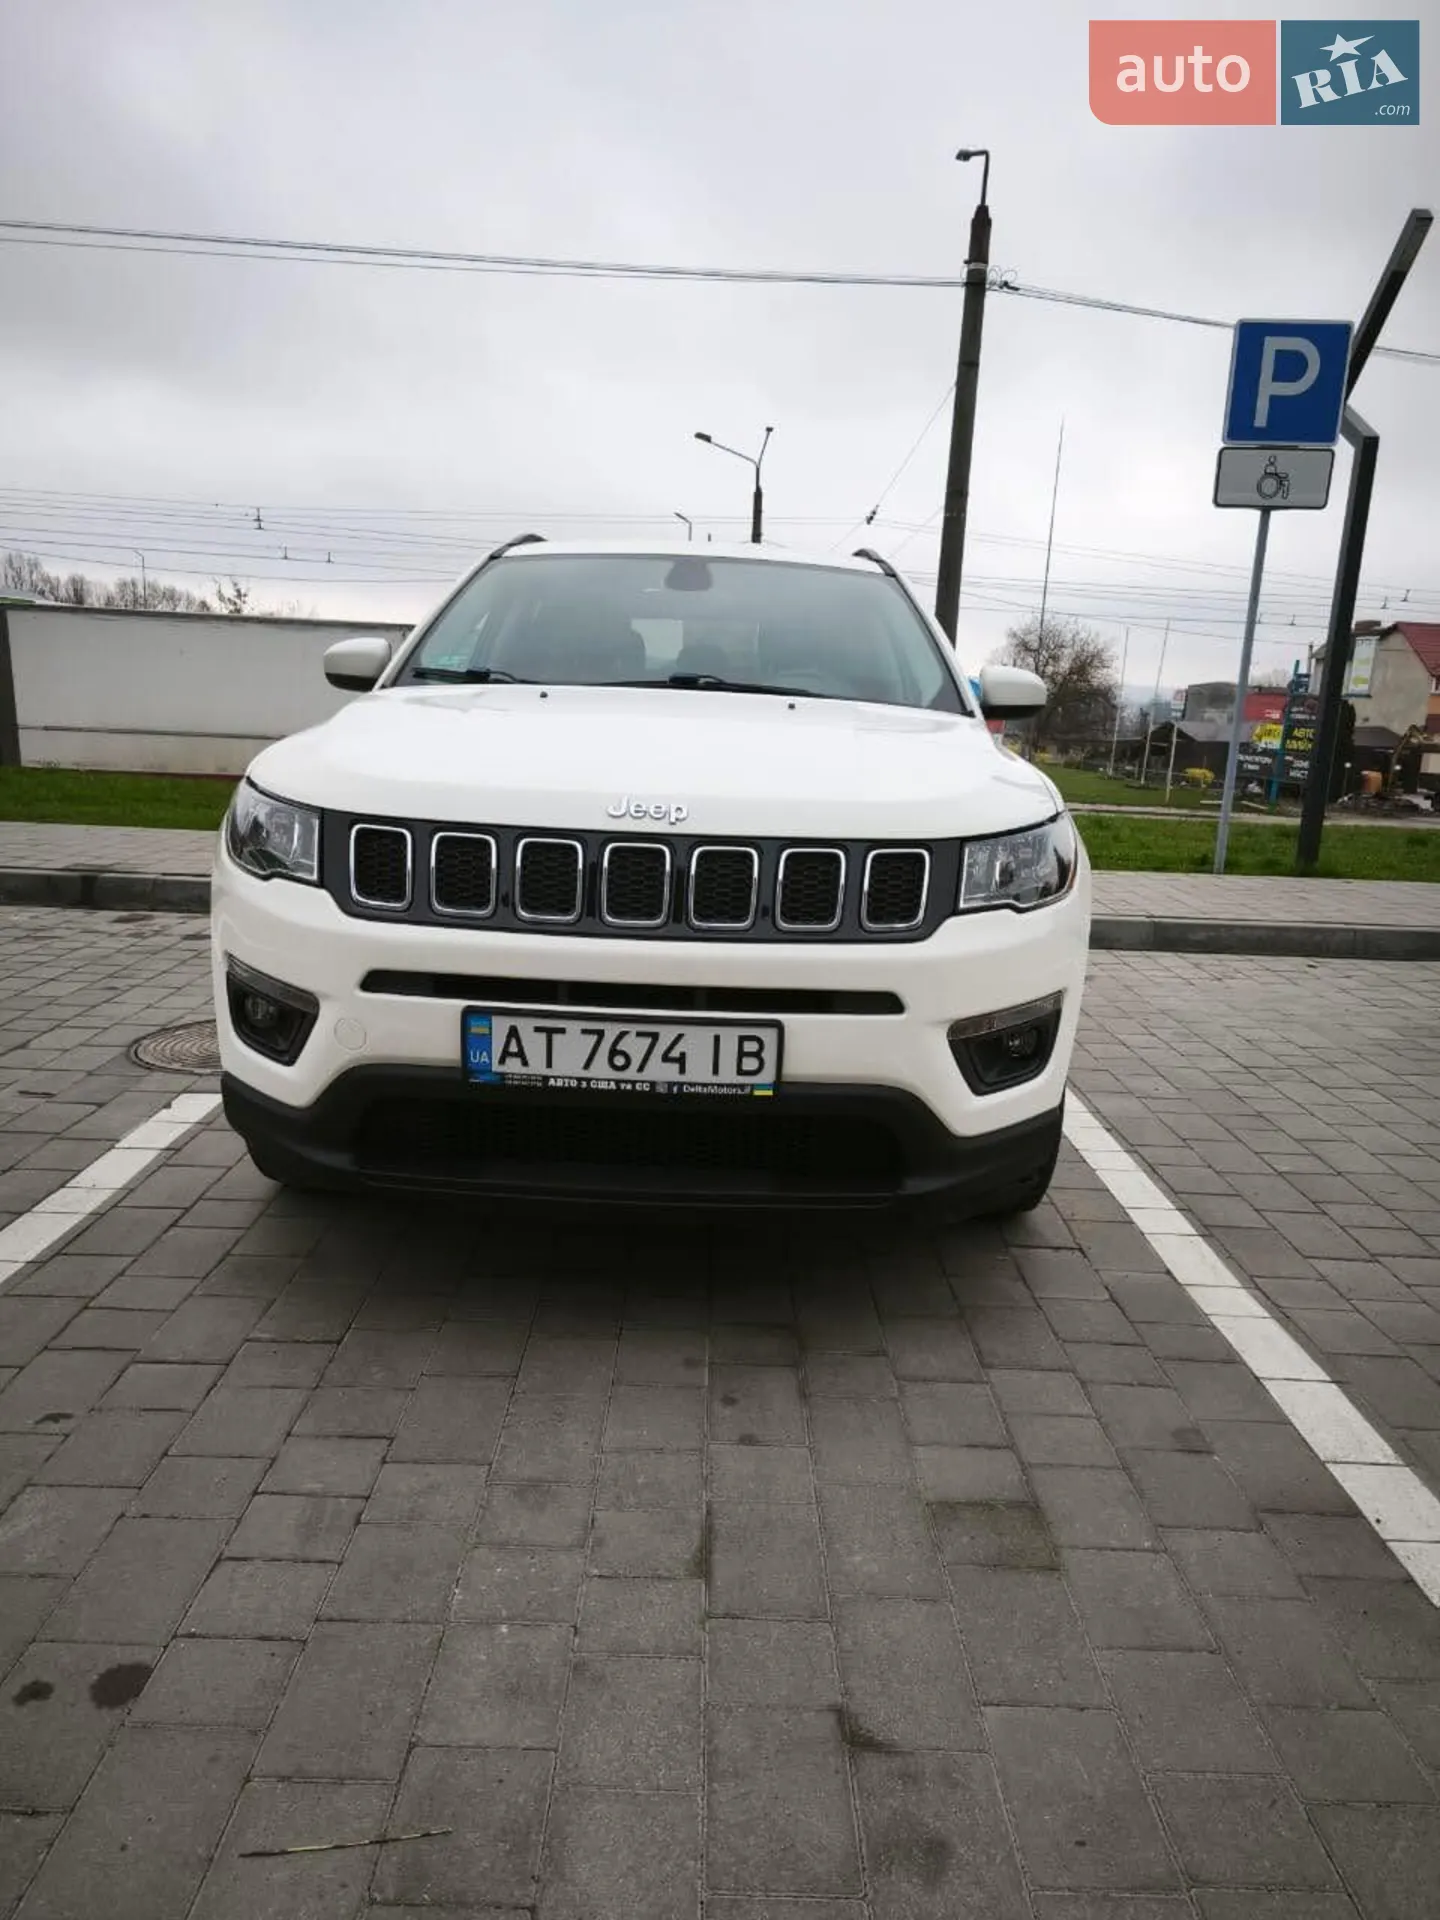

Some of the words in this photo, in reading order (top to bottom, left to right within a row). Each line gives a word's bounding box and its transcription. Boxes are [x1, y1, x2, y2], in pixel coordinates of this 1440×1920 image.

[1254, 336, 1320, 428] P
[606, 795, 688, 825] Jeep
[470, 1050, 490, 1065] UA
[497, 1024, 566, 1069] AT
[580, 1028, 687, 1075] 7674
[712, 1033, 766, 1077] IB
